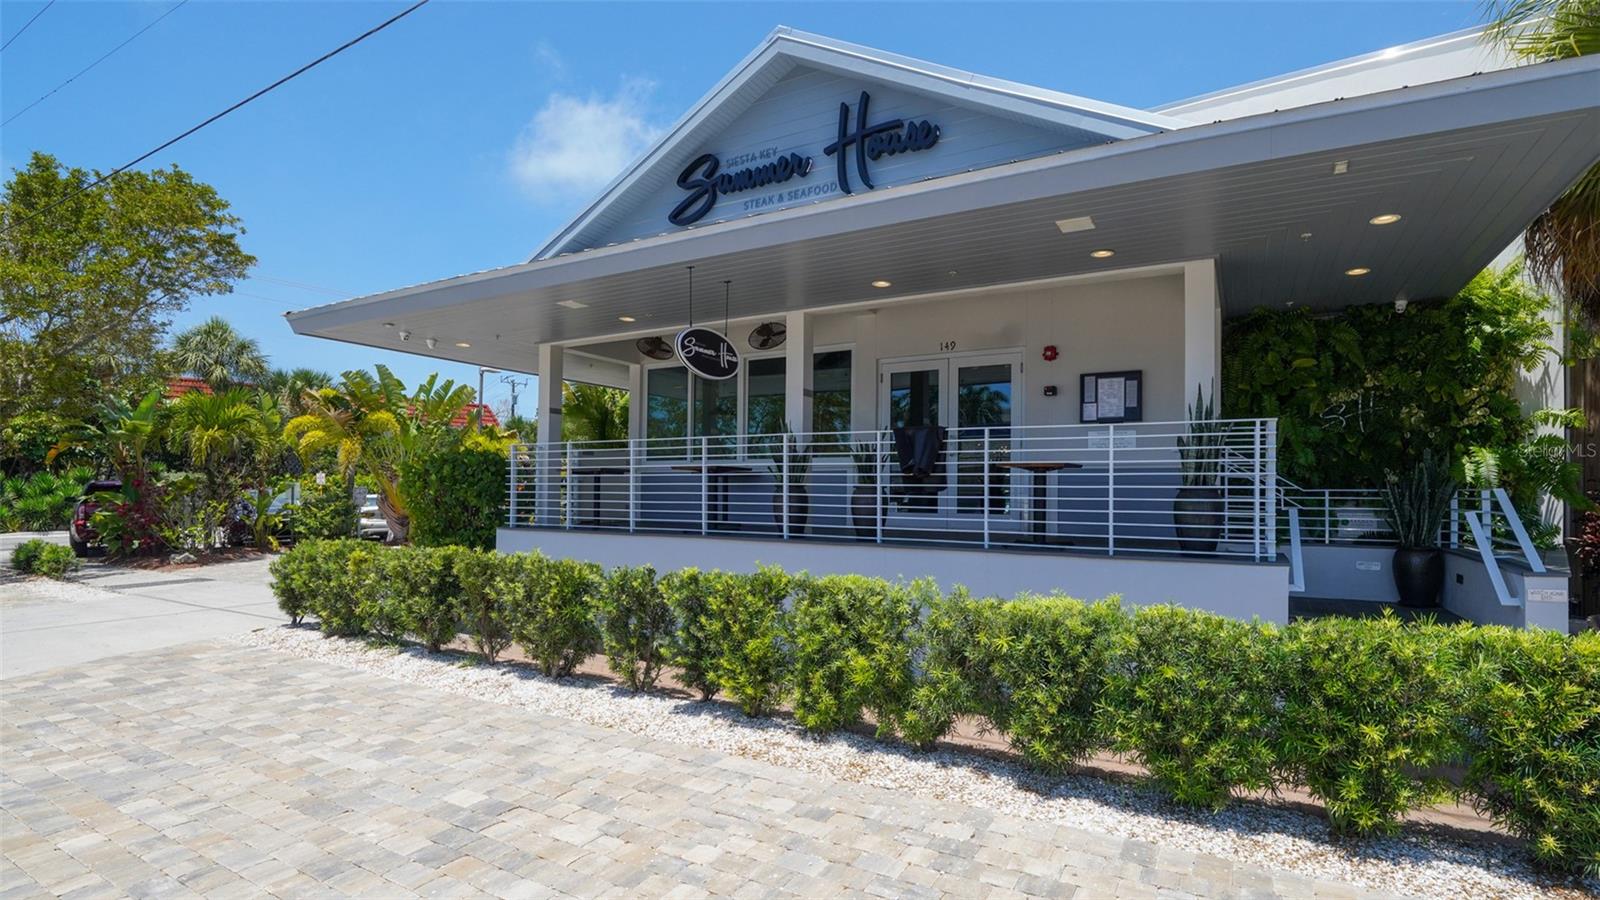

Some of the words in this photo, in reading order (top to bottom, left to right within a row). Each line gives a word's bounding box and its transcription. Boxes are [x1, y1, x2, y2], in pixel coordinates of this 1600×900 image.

[668, 152, 814, 227] Summer
[823, 90, 941, 196] House
[726, 151, 758, 169] SIESTA
[759, 146, 779, 161] KEY
[743, 192, 776, 212] STEAK
[777, 194, 785, 203] &
[787, 182, 838, 202] SEAFOOD
[940, 340, 956, 351] 149
